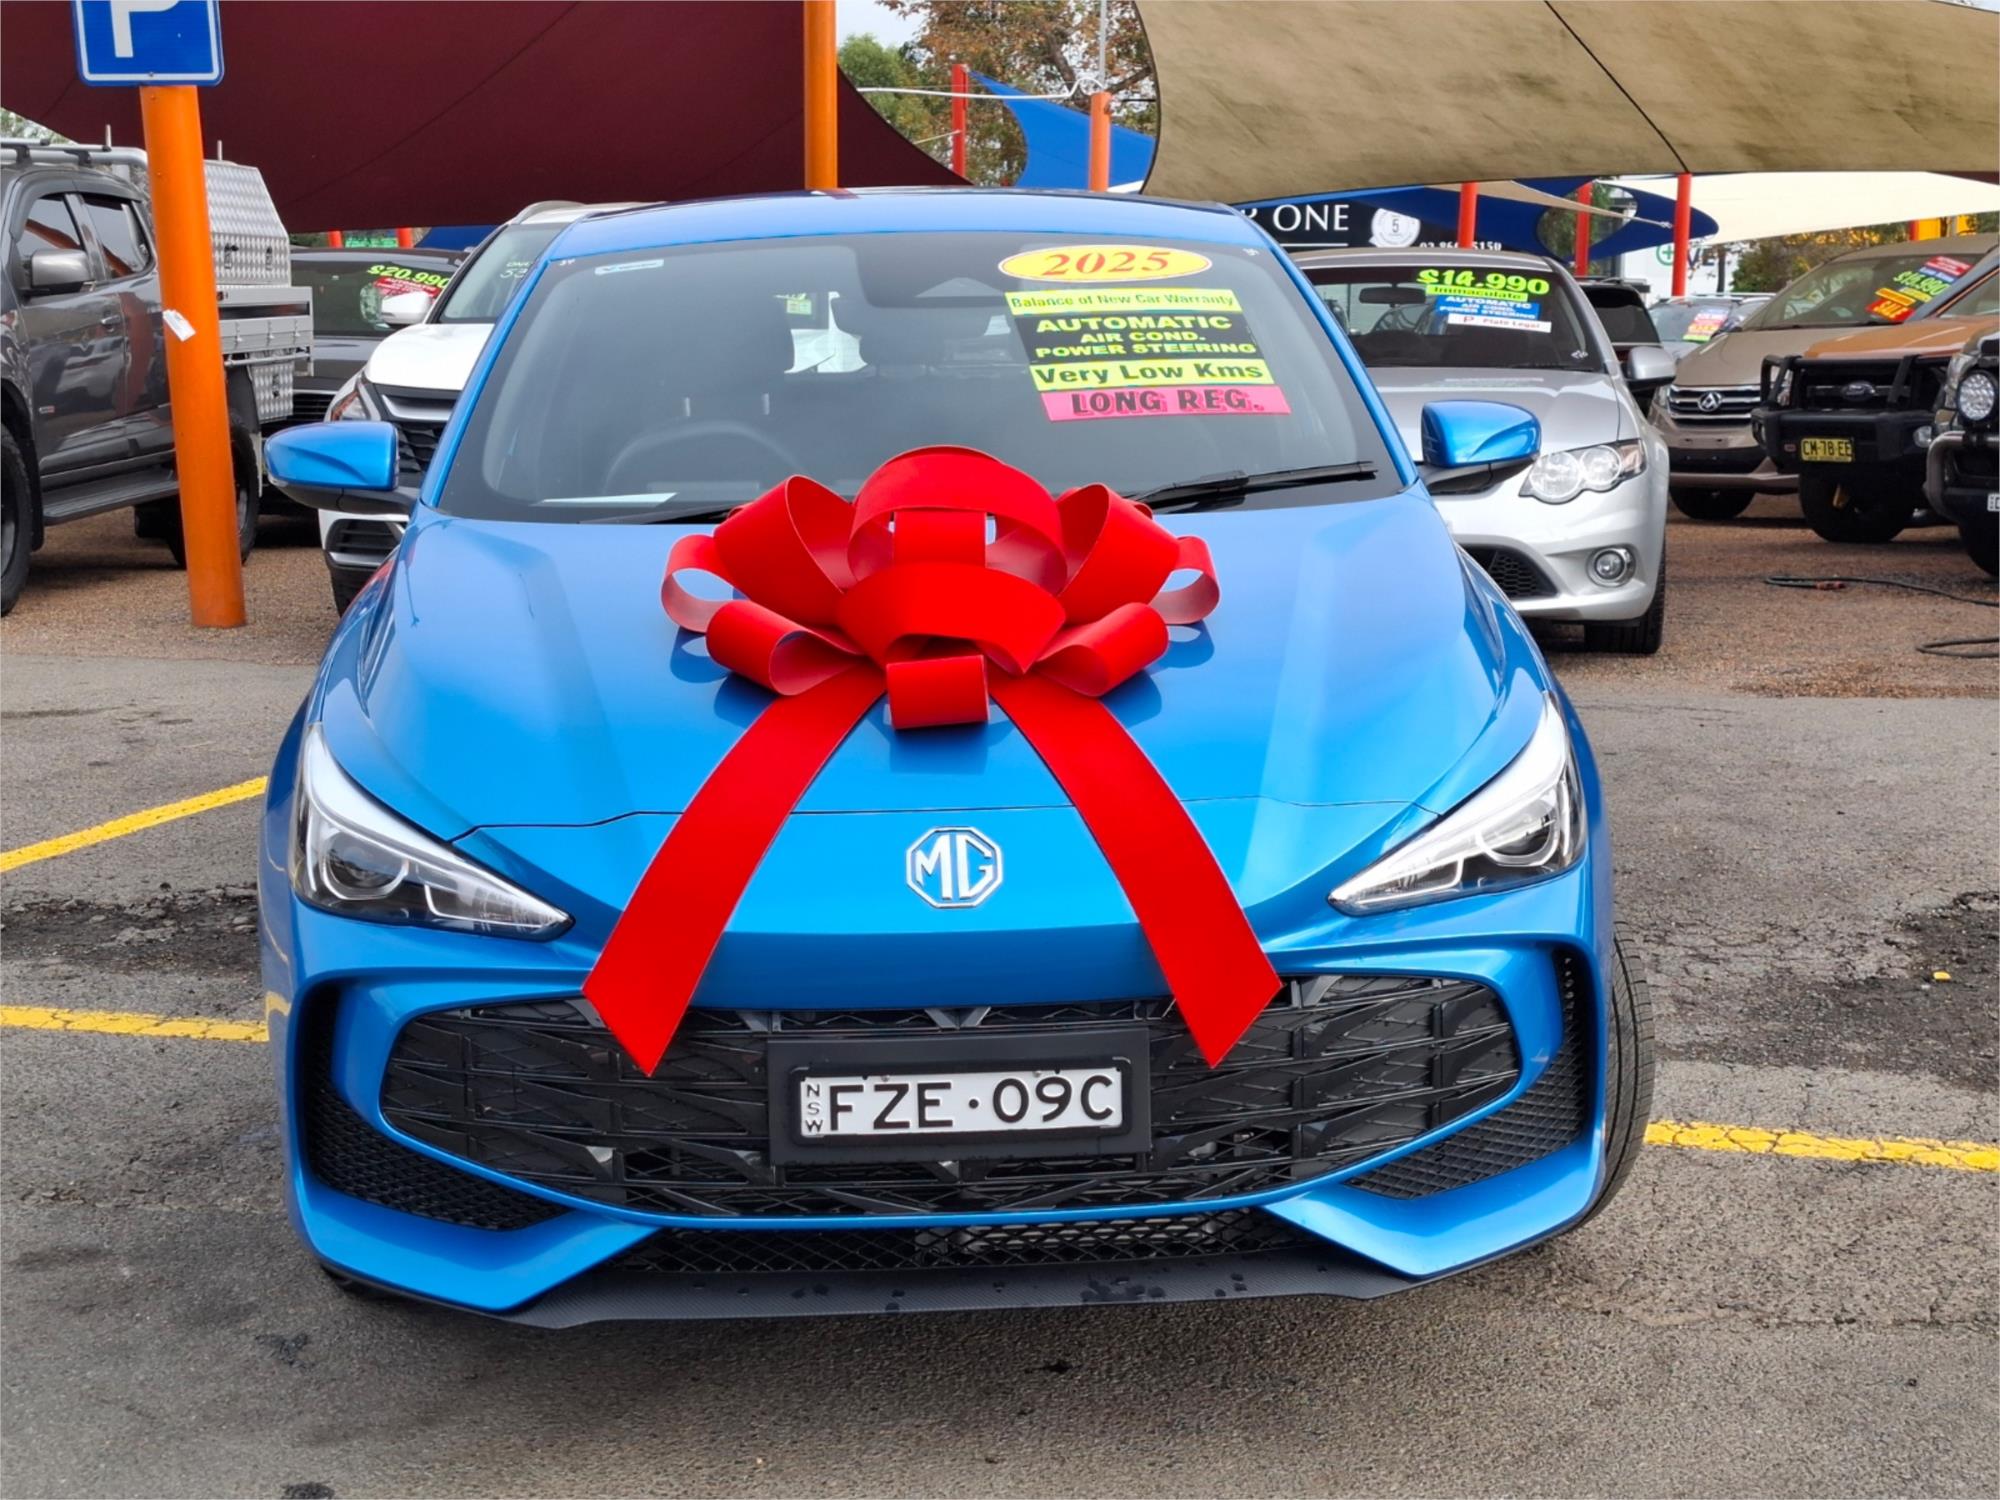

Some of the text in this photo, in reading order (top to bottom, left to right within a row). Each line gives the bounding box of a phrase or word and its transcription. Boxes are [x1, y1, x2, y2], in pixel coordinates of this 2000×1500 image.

[1272, 204, 1350, 232] ONE
[1042, 251, 1171, 276] 2025
[1416, 269, 1549, 295] $14.990
[1011, 293, 1233, 308] Balance of New Car Warranty
[1445, 296, 1532, 310] AUTOMATIC
[1036, 315, 1233, 333] AUTOMATIC
[1080, 331, 1206, 343] AIR COND.
[1035, 343, 1257, 358] POWER STEERING
[1035, 363, 1264, 384] Very Low Kms
[1071, 389, 1265, 416] LONG REG.
[914, 833, 994, 900] MG
